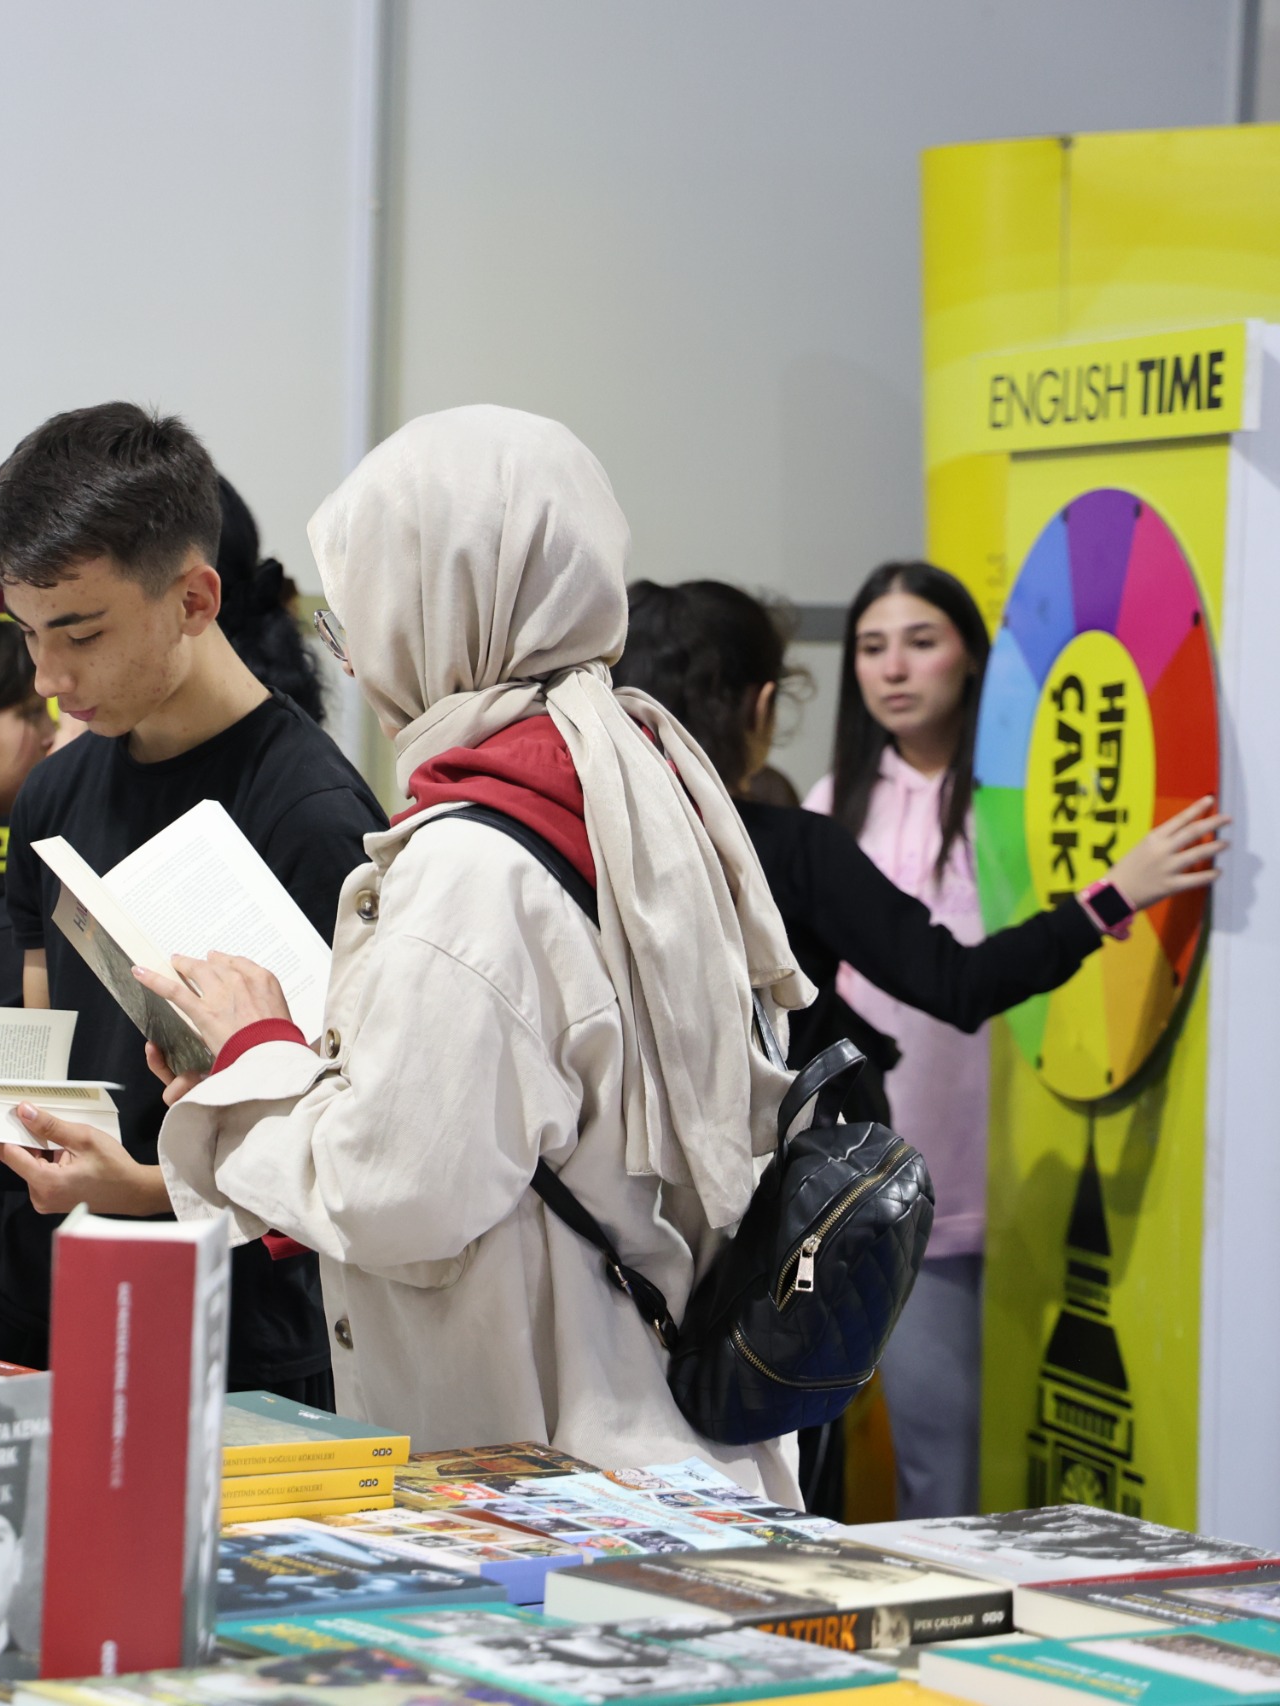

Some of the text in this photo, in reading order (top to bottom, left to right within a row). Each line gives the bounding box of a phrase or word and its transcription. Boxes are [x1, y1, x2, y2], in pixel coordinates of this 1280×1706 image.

[988, 350, 1226, 430] ENGLISH TIME
[934, 1613, 975, 1631] ÇALIŞLAR
